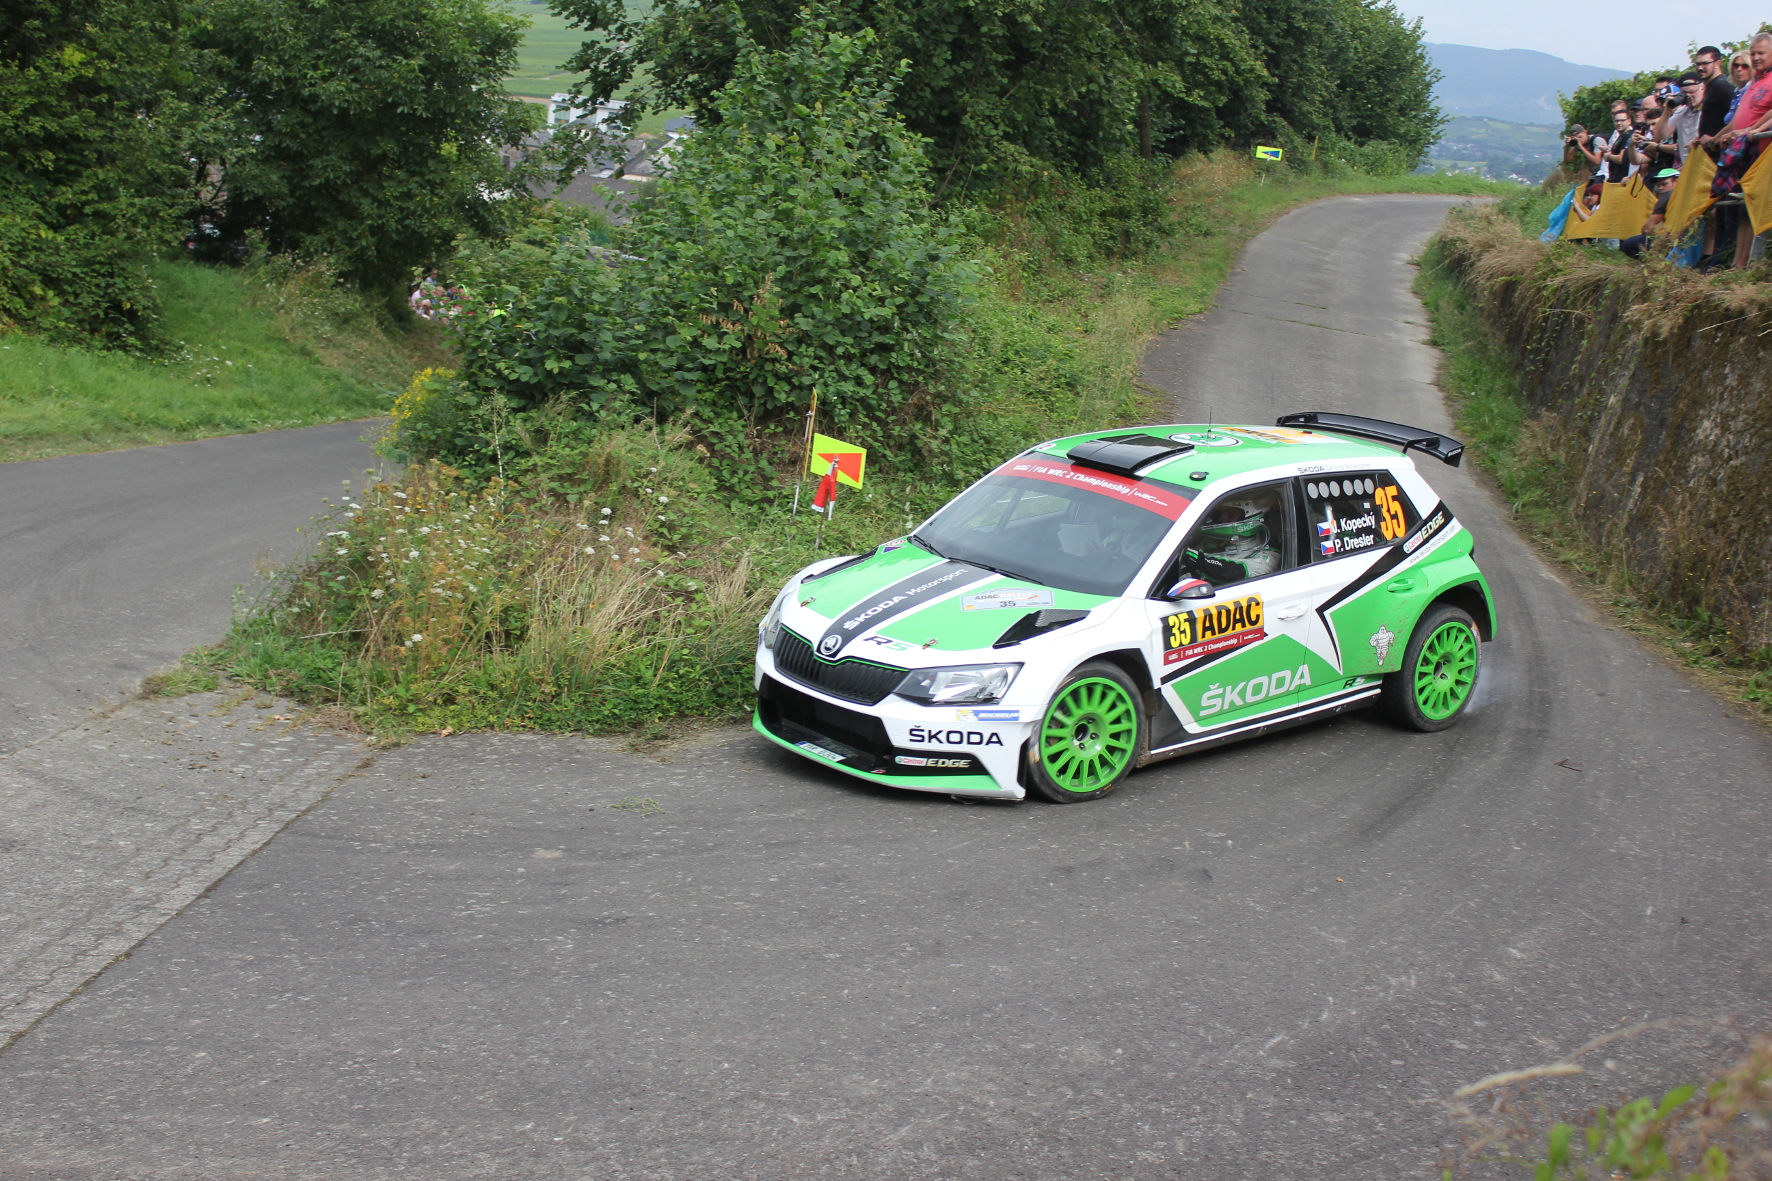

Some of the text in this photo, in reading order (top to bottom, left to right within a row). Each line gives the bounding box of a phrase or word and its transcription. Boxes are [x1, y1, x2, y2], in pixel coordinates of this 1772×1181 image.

[1033, 466, 1046, 474] FIA
[1047, 468, 1064, 478] WRC
[1073, 473, 1131, 495] Championship
[1340, 511, 1375, 533] Kopecký
[1374, 485, 1406, 541] 35
[1421, 511, 1445, 539] EDGE
[1334, 533, 1374, 552] P. Dresler
[843, 568, 968, 630] ŠKODA Motorsport
[999, 600, 1016, 608] 35
[1168, 597, 1261, 648] 35 ADAC
[862, 636, 915, 651] R5
[1185, 649, 1194, 657] FIA
[1194, 646, 1204, 654] WRC
[1208, 637, 1238, 650] Championship
[1199, 663, 1312, 717] ŠKODA
[1342, 675, 1367, 689] R5
[909, 725, 1004, 746] ŠKODA
[926, 758, 972, 768] EDGE
